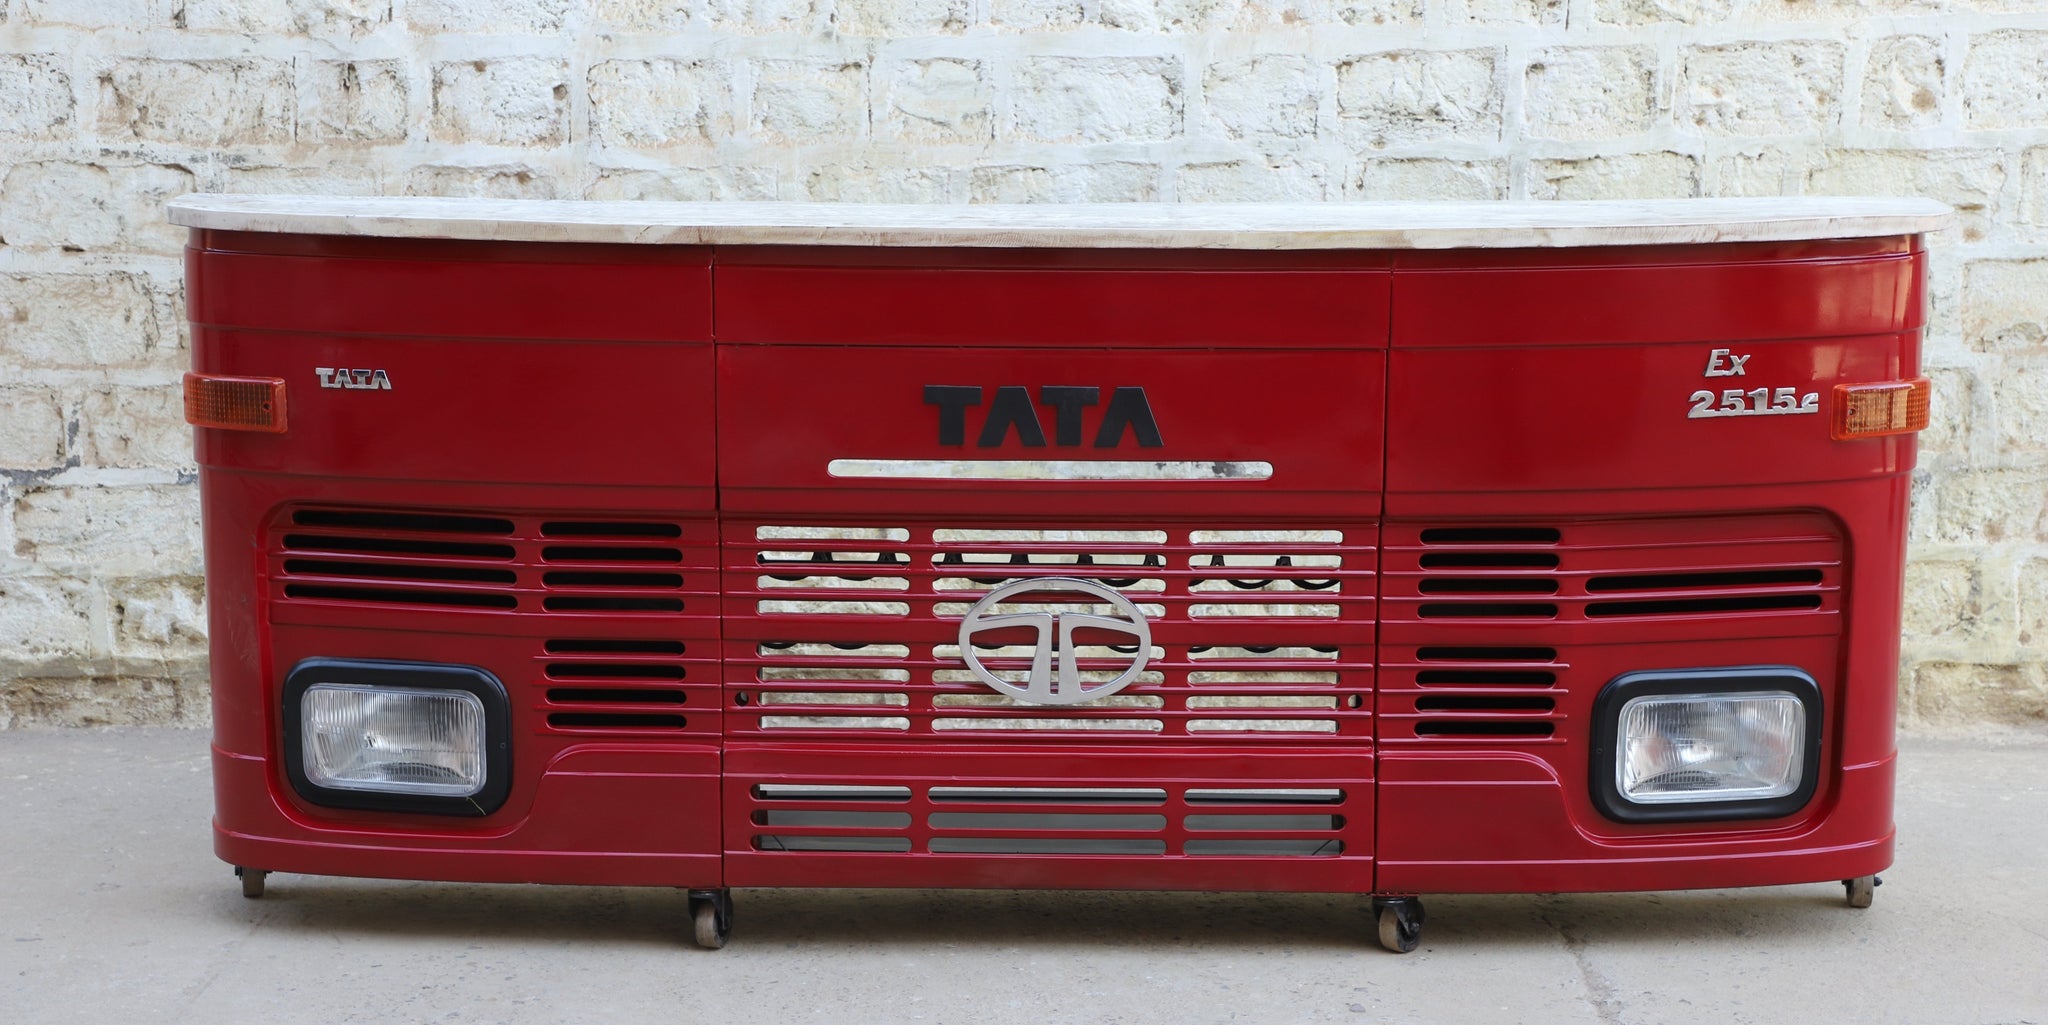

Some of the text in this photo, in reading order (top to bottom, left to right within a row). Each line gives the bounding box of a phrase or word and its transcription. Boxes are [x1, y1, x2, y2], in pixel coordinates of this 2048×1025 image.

[1704, 348, 1751, 377] Ex
[315, 367, 392, 390] TATA
[923, 384, 1165, 449] TATA
